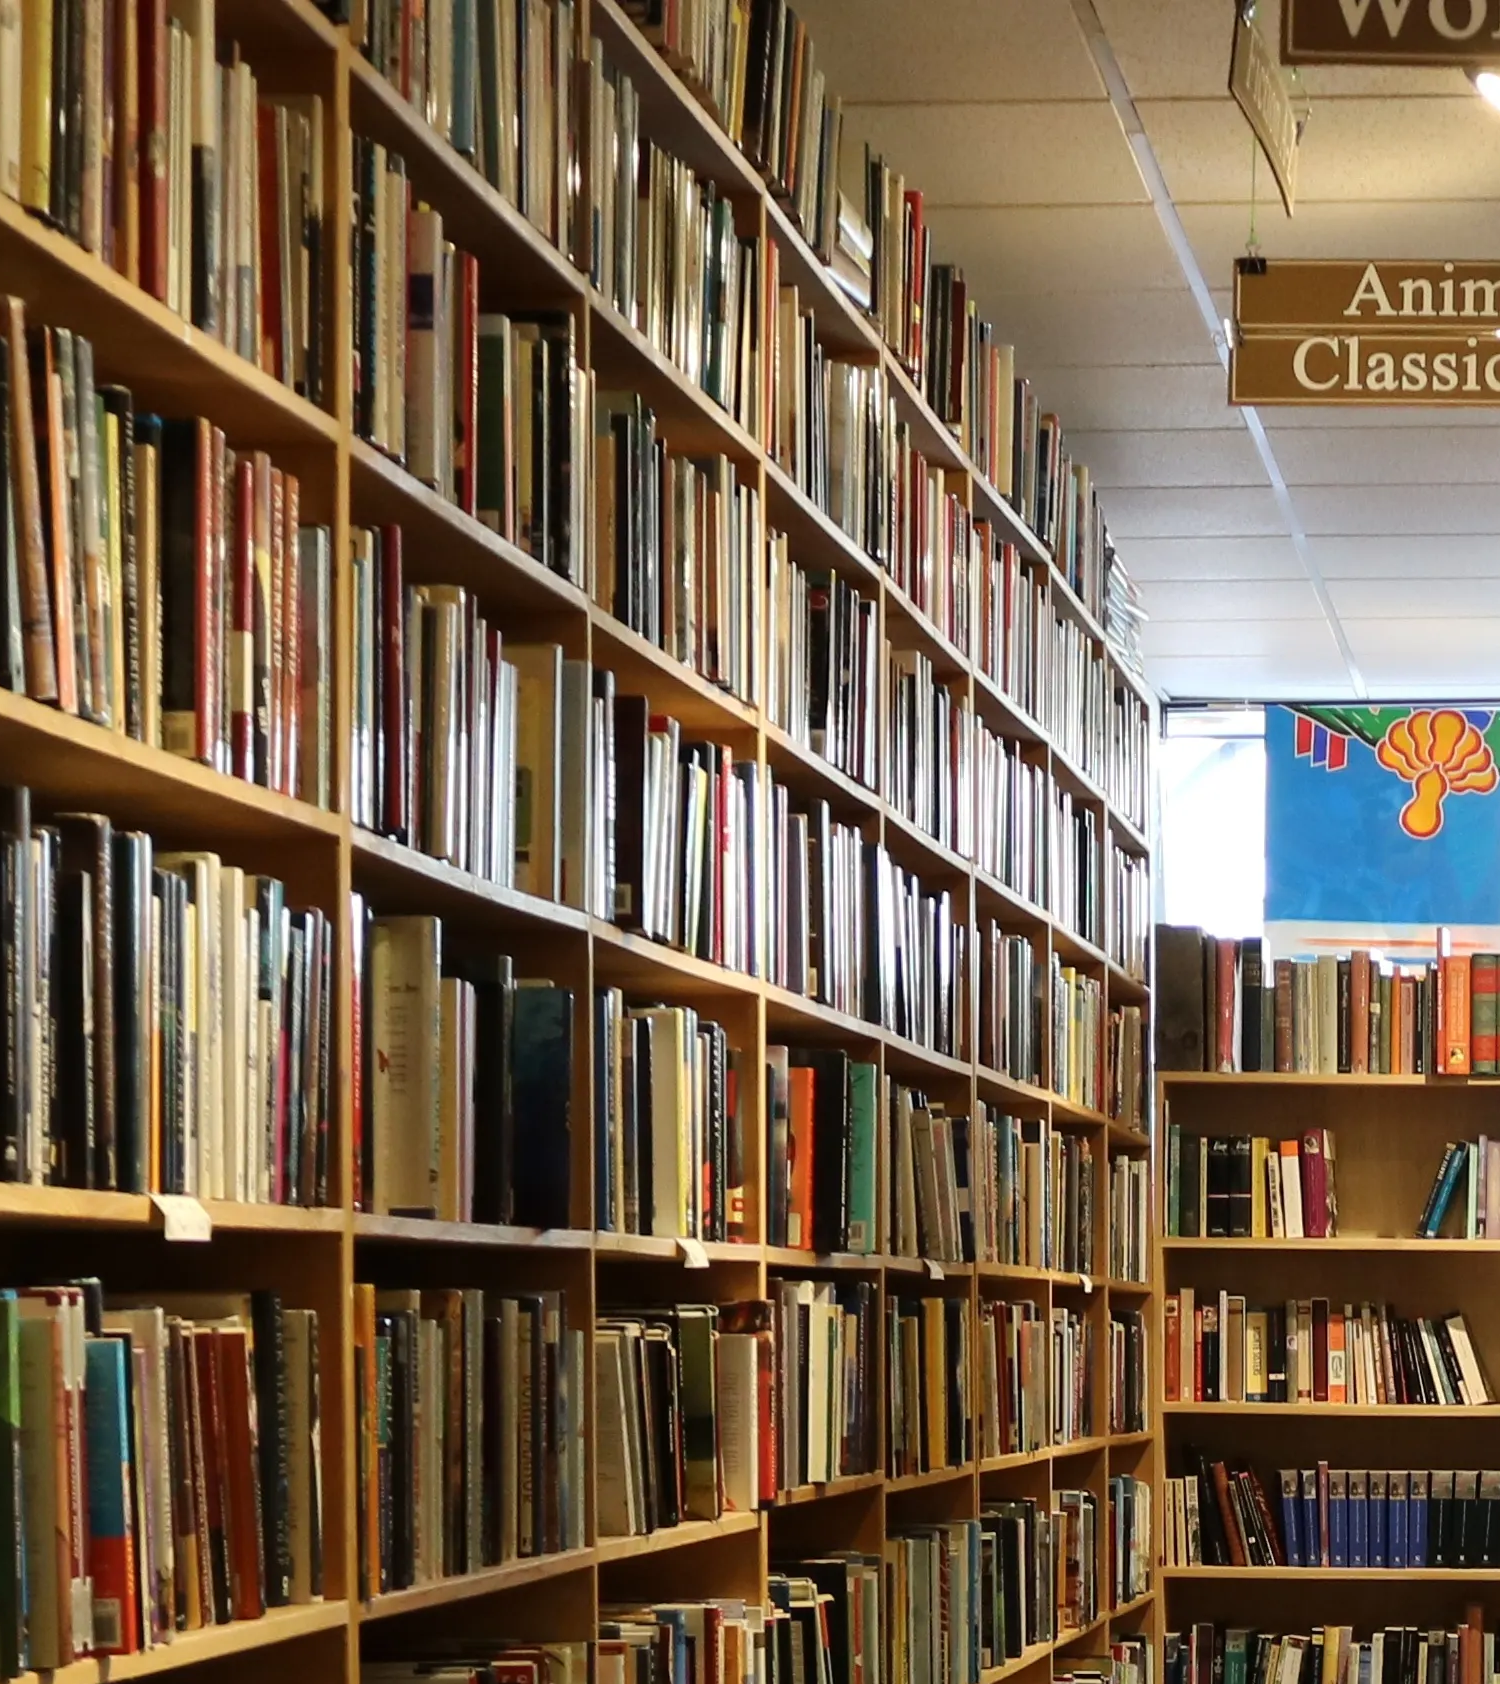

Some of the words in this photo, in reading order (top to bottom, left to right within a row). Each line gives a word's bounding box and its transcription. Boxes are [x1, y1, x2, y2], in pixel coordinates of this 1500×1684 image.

[126, 534, 138, 608] ROBERT
[273, 551, 283, 668] MERMAID
[128, 617, 140, 690] HARRIS
[287, 564, 298, 676] MERMAID
[273, 1296, 284, 1362] DARK
[276, 1373, 287, 1480] HARBOR
